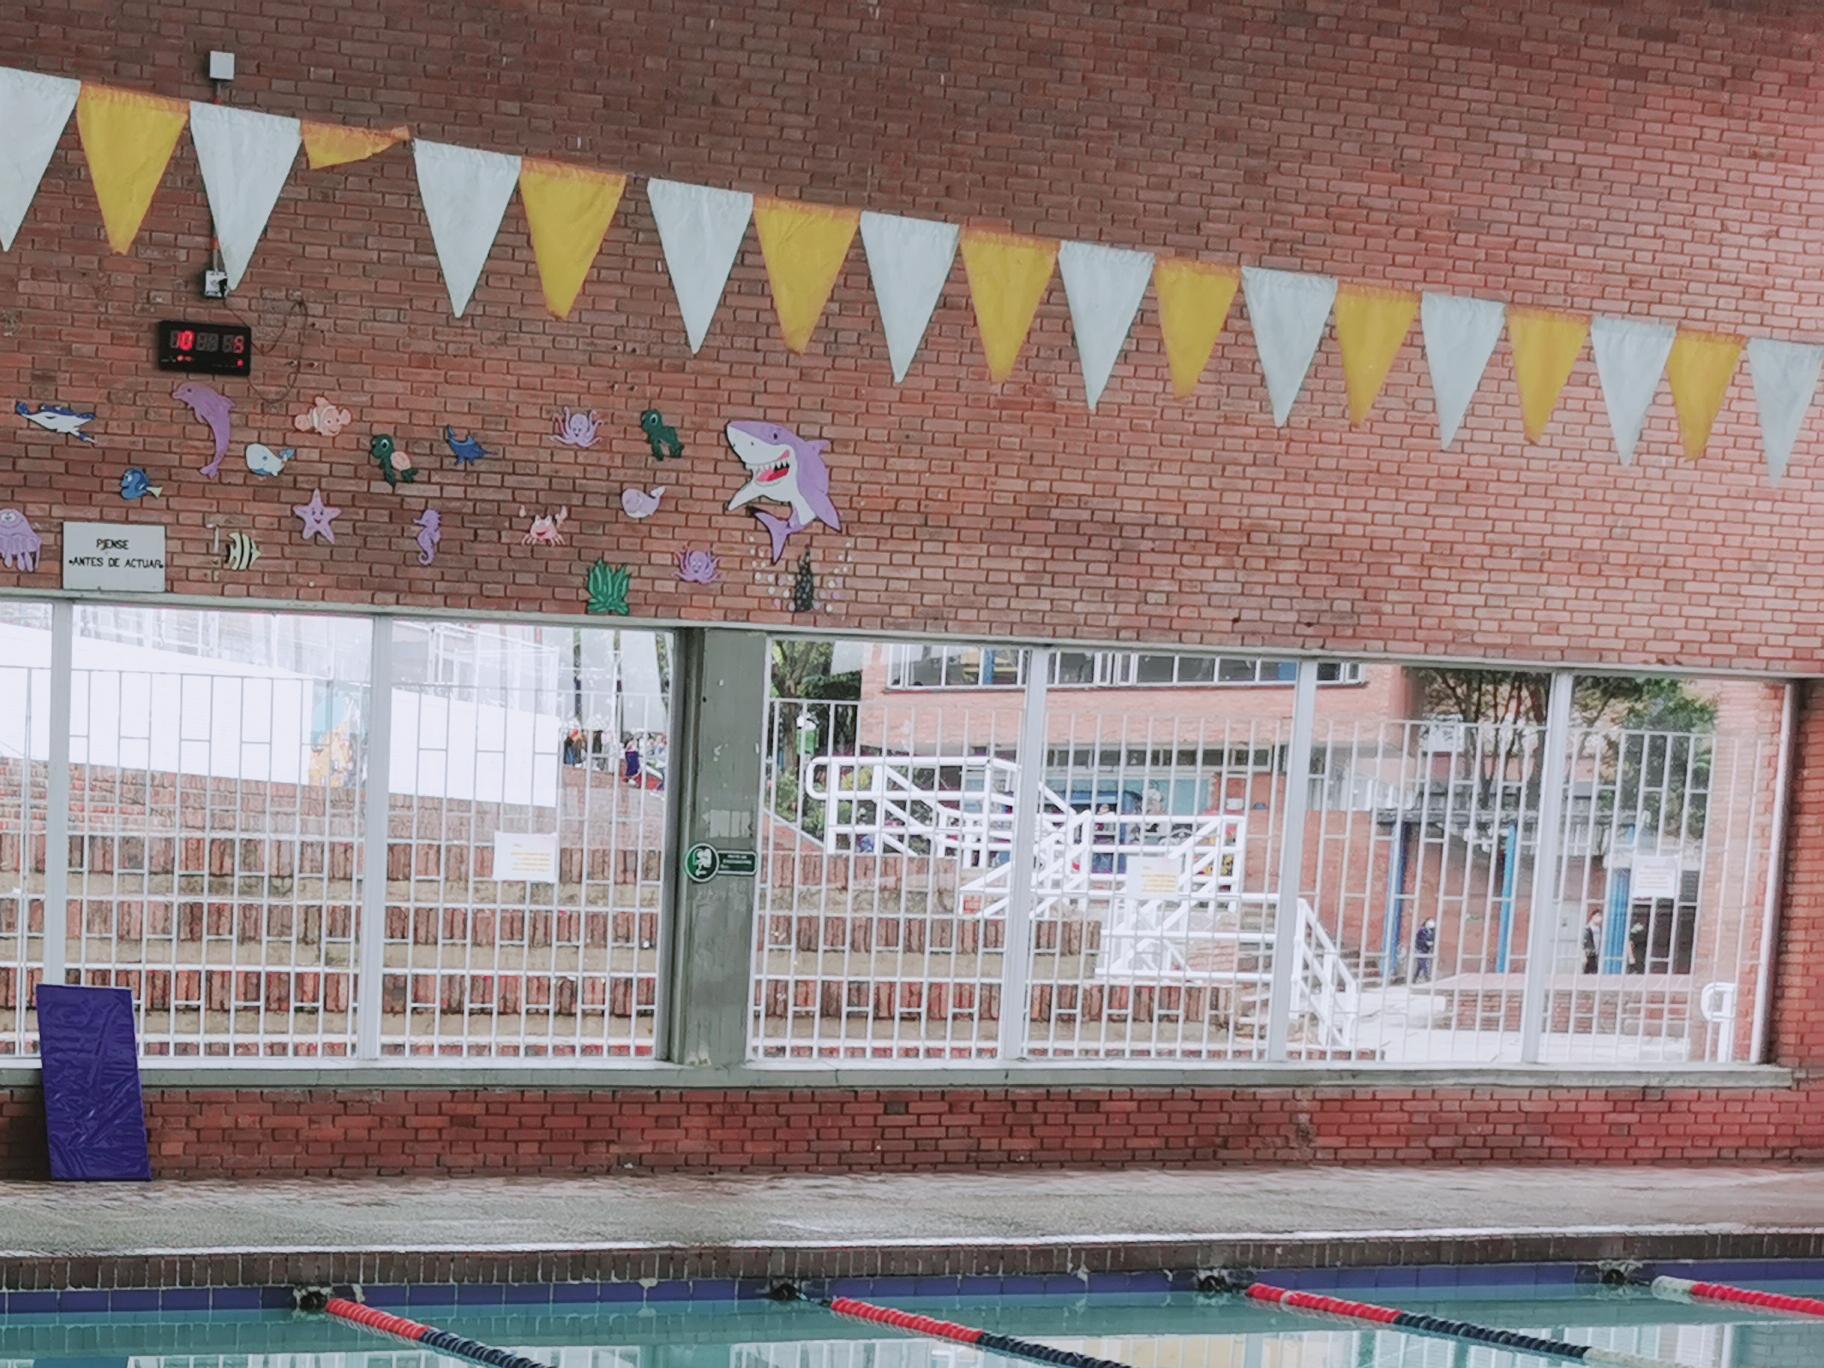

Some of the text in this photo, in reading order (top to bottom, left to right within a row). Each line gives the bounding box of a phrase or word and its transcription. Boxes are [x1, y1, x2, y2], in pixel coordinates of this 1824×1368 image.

[96, 538, 129, 551] PIENSE
[72, 556, 162, 569] ANTES DE ACTUAR
